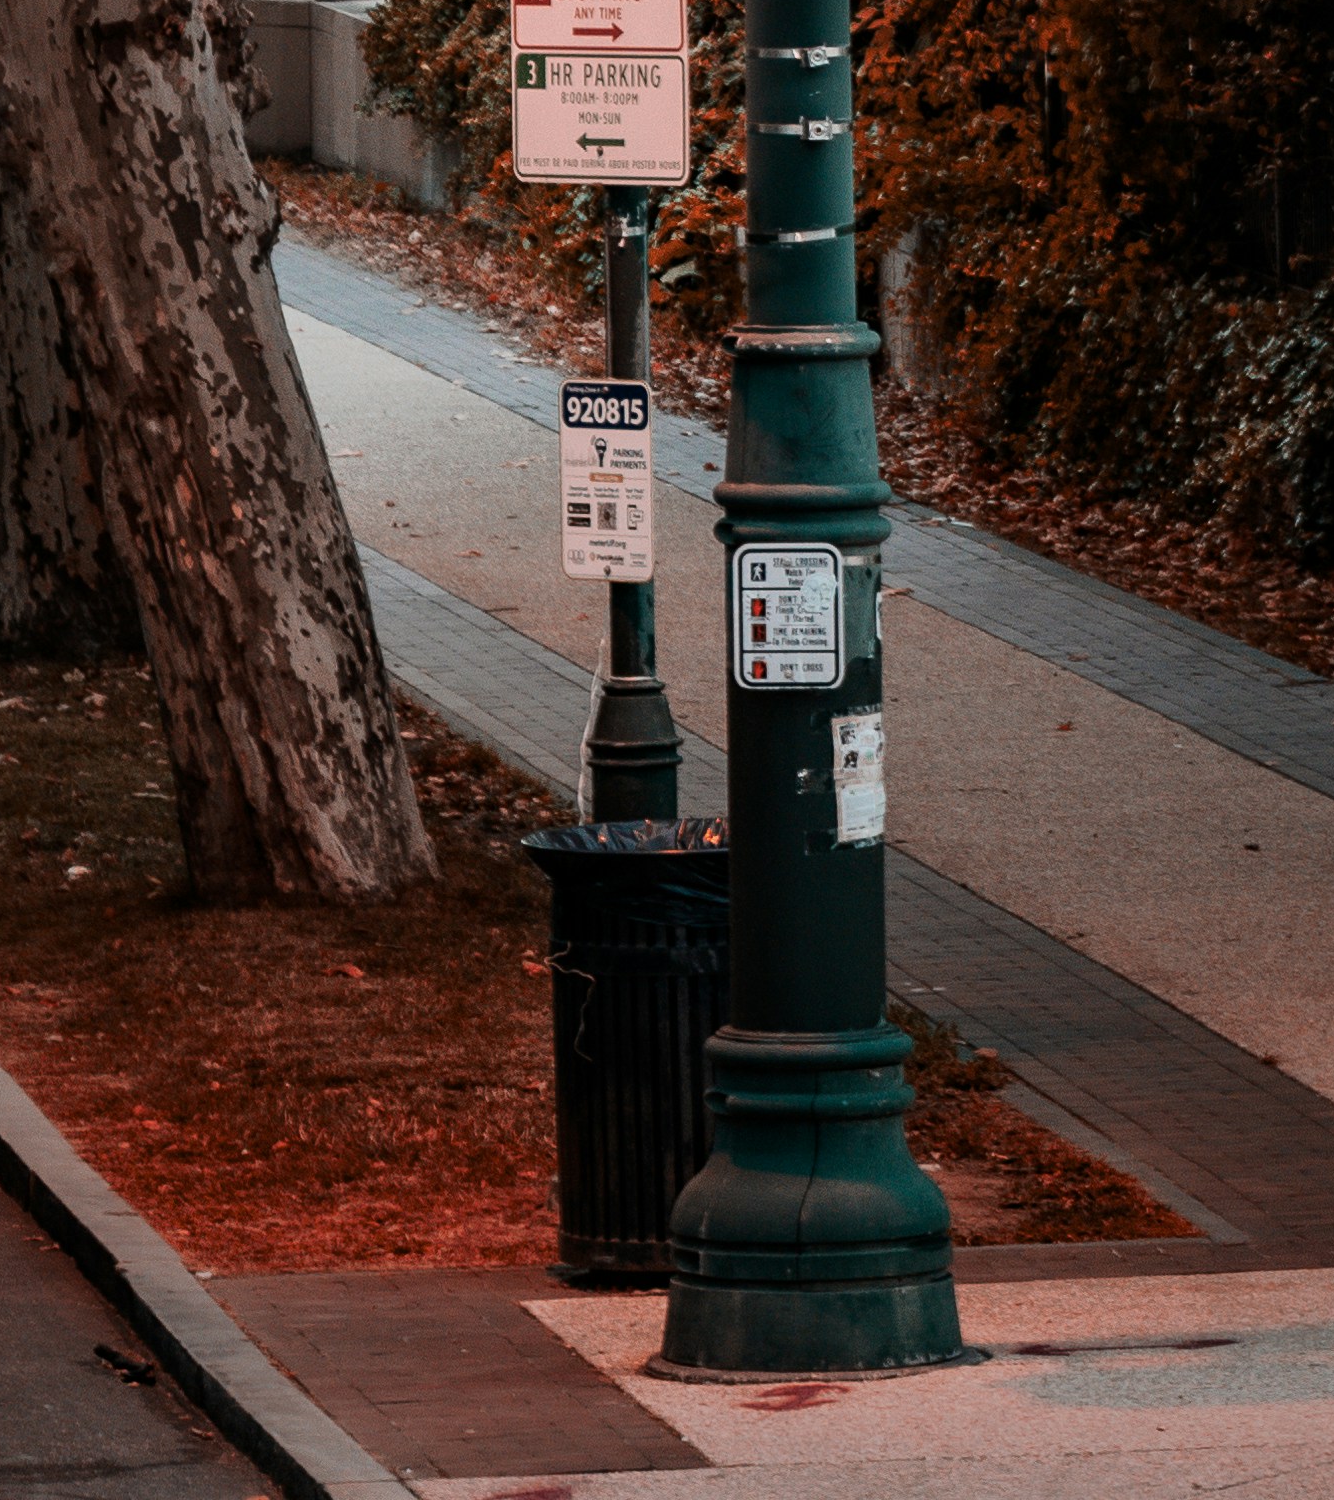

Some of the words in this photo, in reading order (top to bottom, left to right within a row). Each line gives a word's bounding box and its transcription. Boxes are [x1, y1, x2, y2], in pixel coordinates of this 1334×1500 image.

[574, 7, 595, 19] ANY
[599, 7, 622, 20] TIME
[527, 60, 538, 86] 3
[550, 62, 573, 87] HR
[583, 63, 662, 88] PARKING
[578, 111, 622, 125] MON-SUN
[563, 158, 579, 168] PAID
[567, 396, 644, 426] 920815
[612, 448, 644, 458] PARKING
[610, 459, 647, 470] PAYMENTS
[795, 557, 828, 567] CROSSING
[802, 663, 824, 672] CROSS
